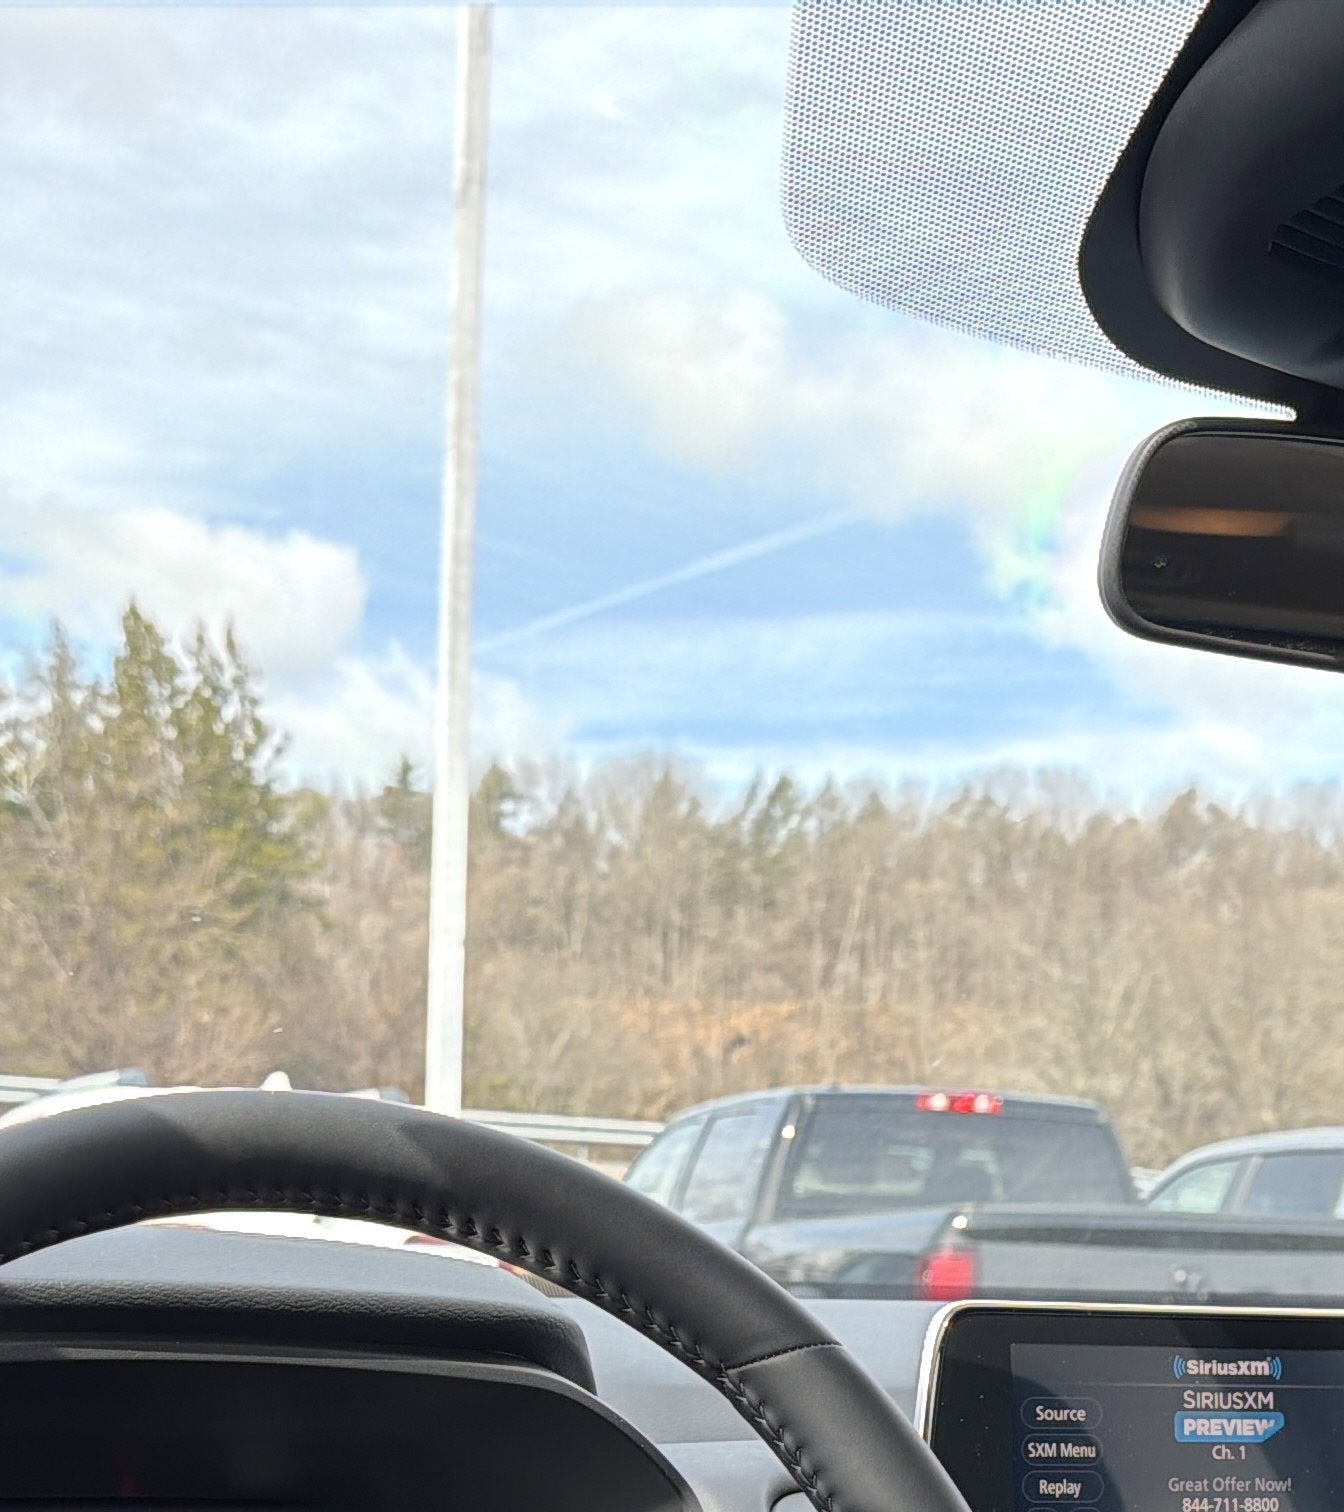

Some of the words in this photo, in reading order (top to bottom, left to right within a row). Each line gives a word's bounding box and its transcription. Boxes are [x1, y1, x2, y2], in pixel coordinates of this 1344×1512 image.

[1183, 1390, 1275, 1410] SIRIUSXM
[1035, 1405, 1087, 1422] Source
[1183, 1419, 1276, 1436] PREVIEW
[1027, 1443, 1057, 1458] SXM
[1060, 1443, 1096, 1458] Menu
[1211, 1445, 1235, 1460] Ch.
[1239, 1446, 1247, 1459] 1
[1039, 1479, 1082, 1498] Replay
[1168, 1477, 1210, 1492] Great
[1212, 1476, 1252, 1492] Offer
[1254, 1477, 1292, 1492] Now!
[1182, 1497, 1279, 1512] 844-711-8800
